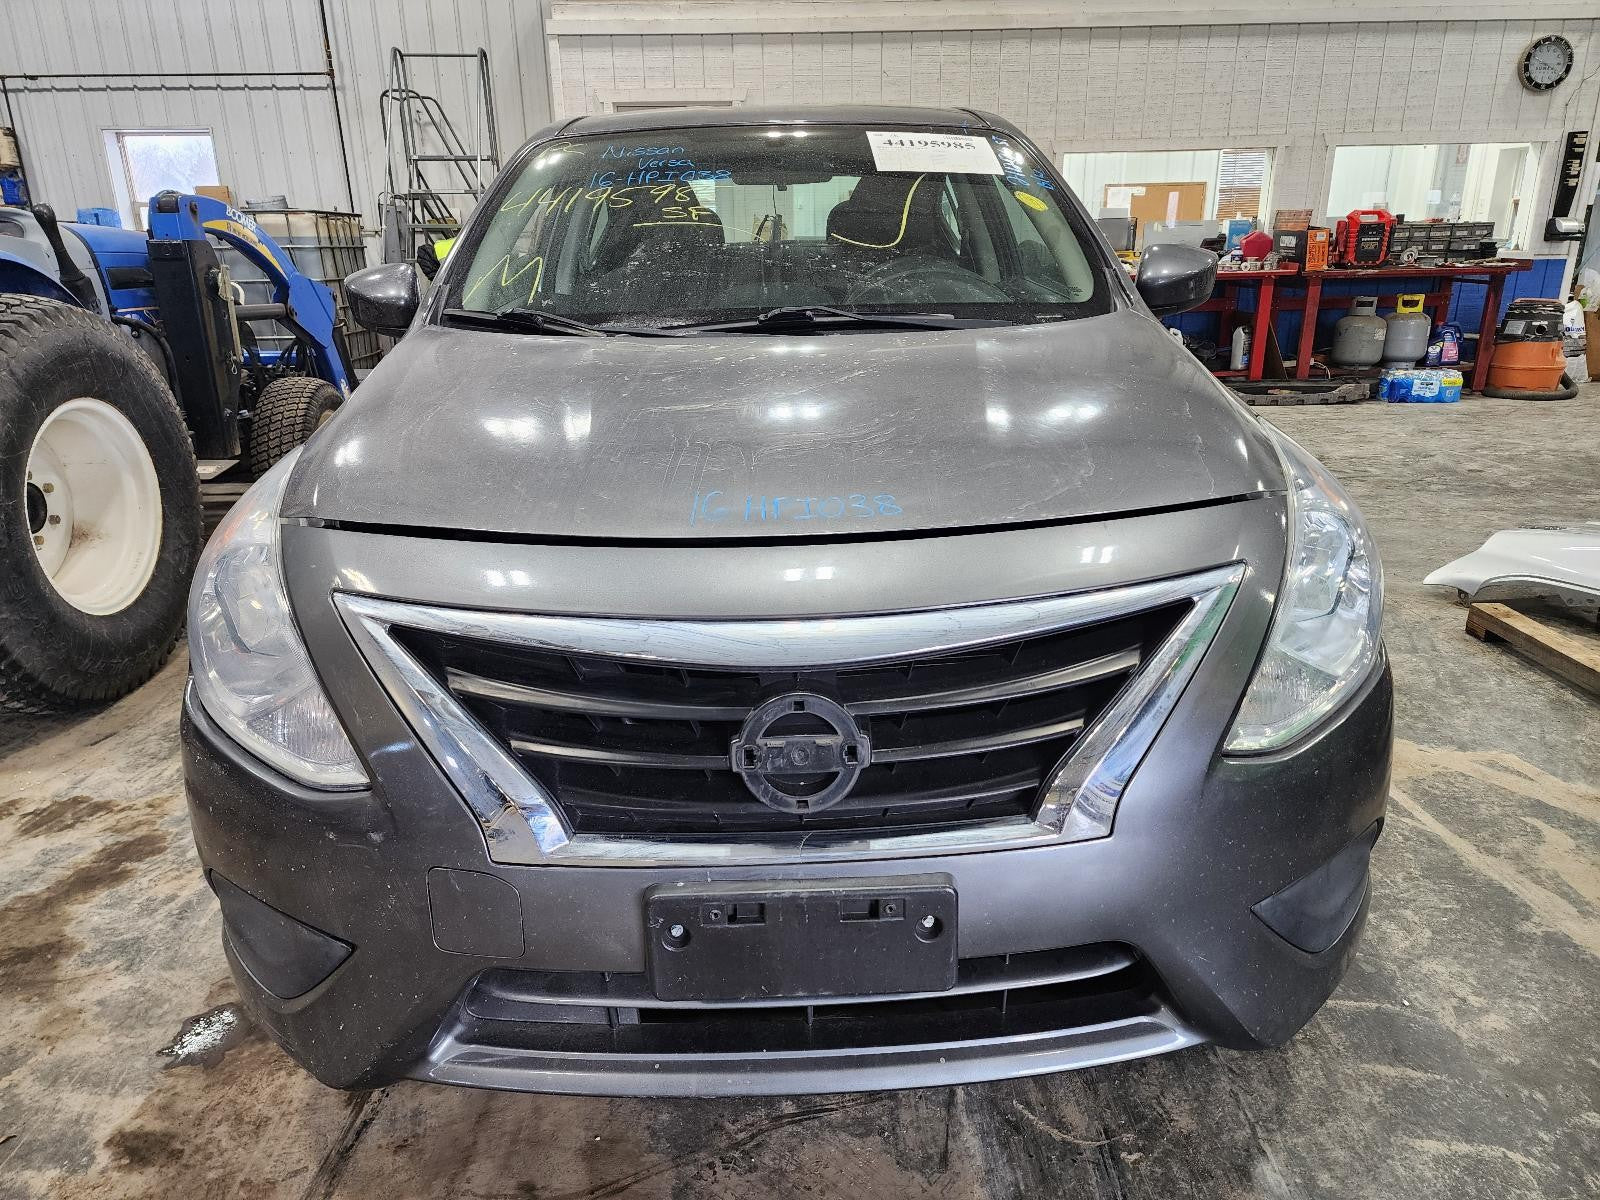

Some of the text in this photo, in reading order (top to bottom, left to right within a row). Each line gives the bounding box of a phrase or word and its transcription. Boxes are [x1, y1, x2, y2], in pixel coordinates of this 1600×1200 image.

[883, 139, 976, 150] 44195985
[602, 144, 684, 158] Nissan
[638, 158, 695, 169] Versa
